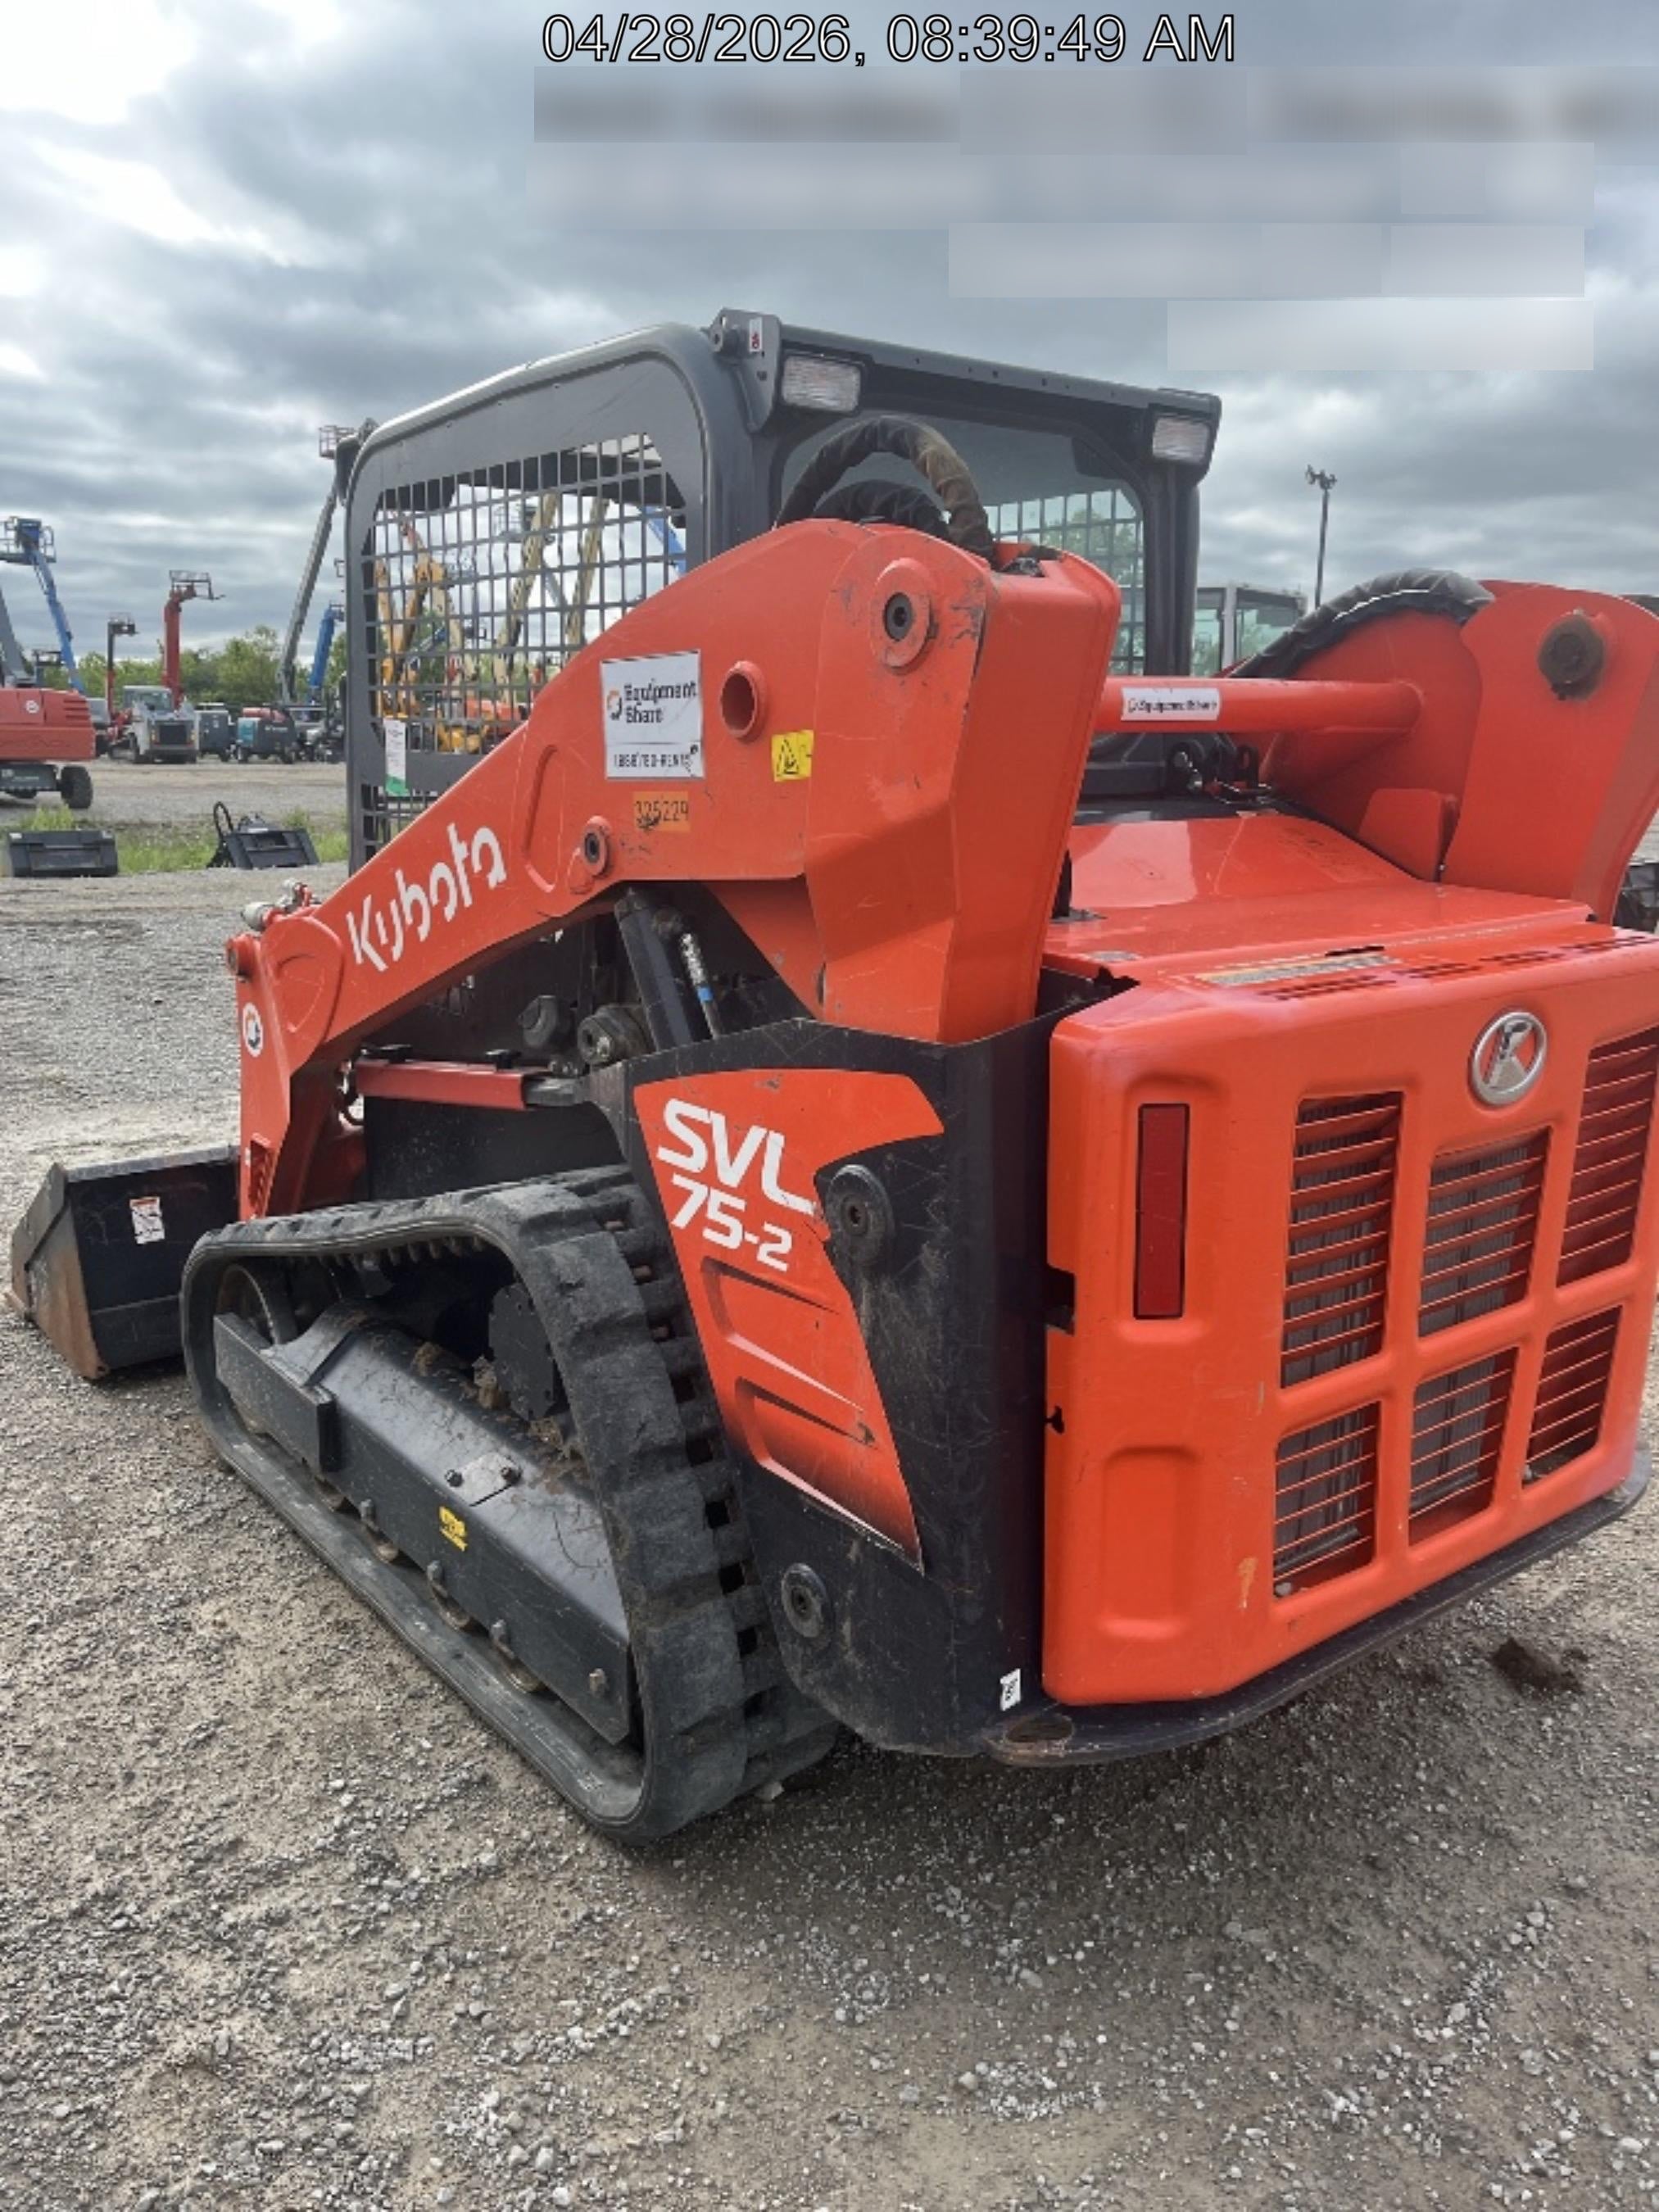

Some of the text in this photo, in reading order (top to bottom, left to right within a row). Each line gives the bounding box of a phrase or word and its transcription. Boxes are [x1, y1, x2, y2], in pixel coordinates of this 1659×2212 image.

[346, 823, 507, 972] Kubota
[656, 1098, 816, 1217] SVL
[670, 1172, 792, 1271] 75-2
